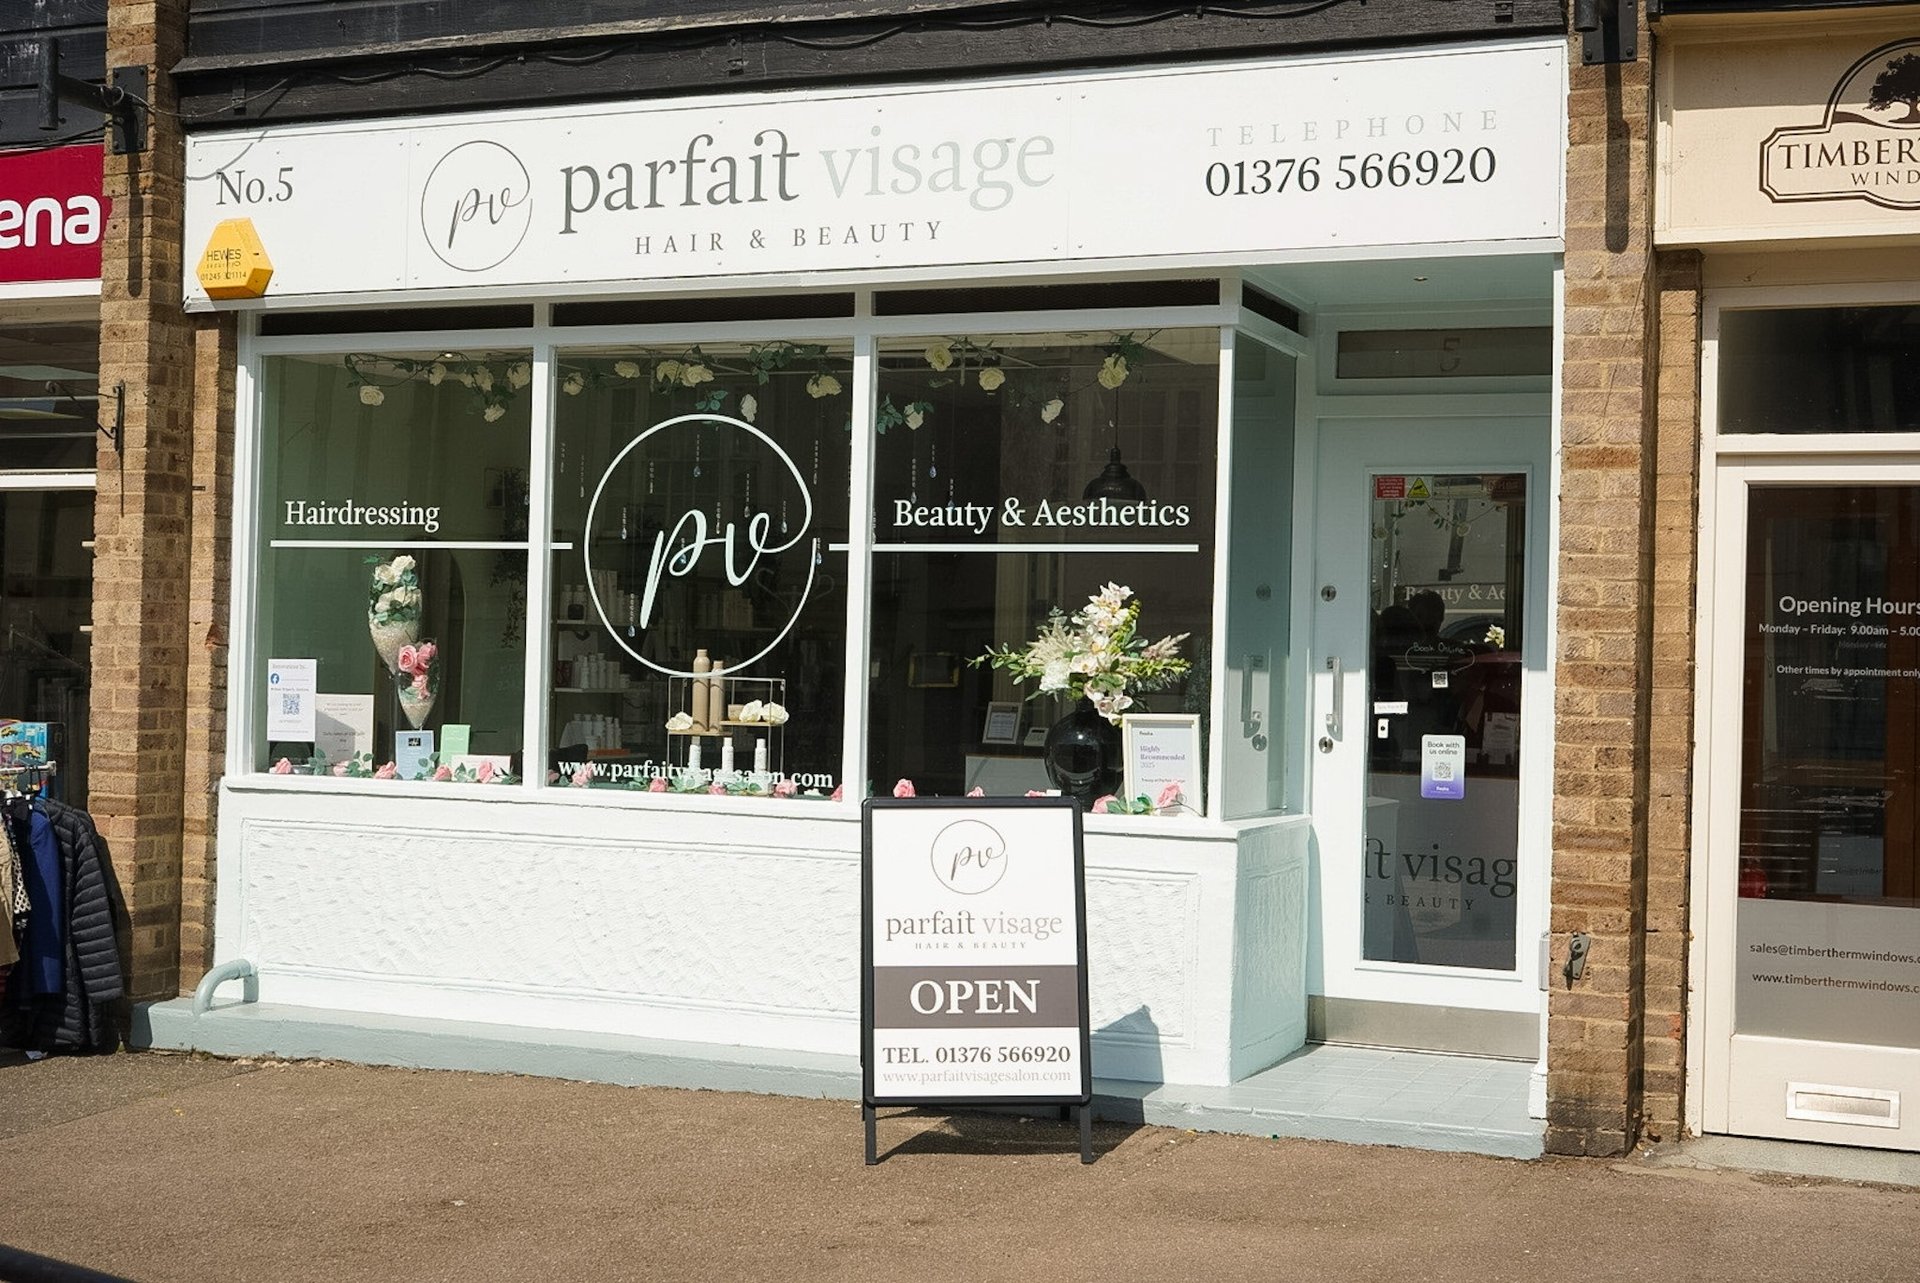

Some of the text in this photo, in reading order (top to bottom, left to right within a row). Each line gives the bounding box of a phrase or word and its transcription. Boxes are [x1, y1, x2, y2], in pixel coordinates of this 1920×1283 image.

[1206, 109, 1498, 147] TELEPHONE
[1778, 138, 1920, 170] TIMBER
[215, 166, 294, 206] No.5
[558, 125, 1056, 236] parfait visage
[1205, 146, 1496, 197] 01376 566920
[0, 194, 101, 250] ena
[635, 220, 943, 255] HAIR & BEAUTY
[284, 500, 441, 533] Hairdressing
[893, 497, 1191, 535] Beauty & Aesthetics
[1404, 585, 1465, 605] Buty
[1779, 595, 1920, 618] Opening Hours
[1758, 623, 1801, 636] Monday
[1810, 624, 1846, 637] Friday:
[1850, 625, 1889, 636] 9.00am
[1776, 664, 1803, 675] Other
[1804, 665, 1830, 676] times
[1831, 666, 1843, 677] by
[1843, 667, 1902, 678] appointment
[1386, 894, 1475, 911] BEAUTY
[886, 910, 1063, 942] parfait visage
[914, 941, 1027, 950] HAIR & BEAUTY
[909, 979, 1041, 1015] OPEN
[883, 1046, 1071, 1064] TEL. 01376 566920
[882, 1068, 1071, 1086] www.parfaitvisagesalon.com
